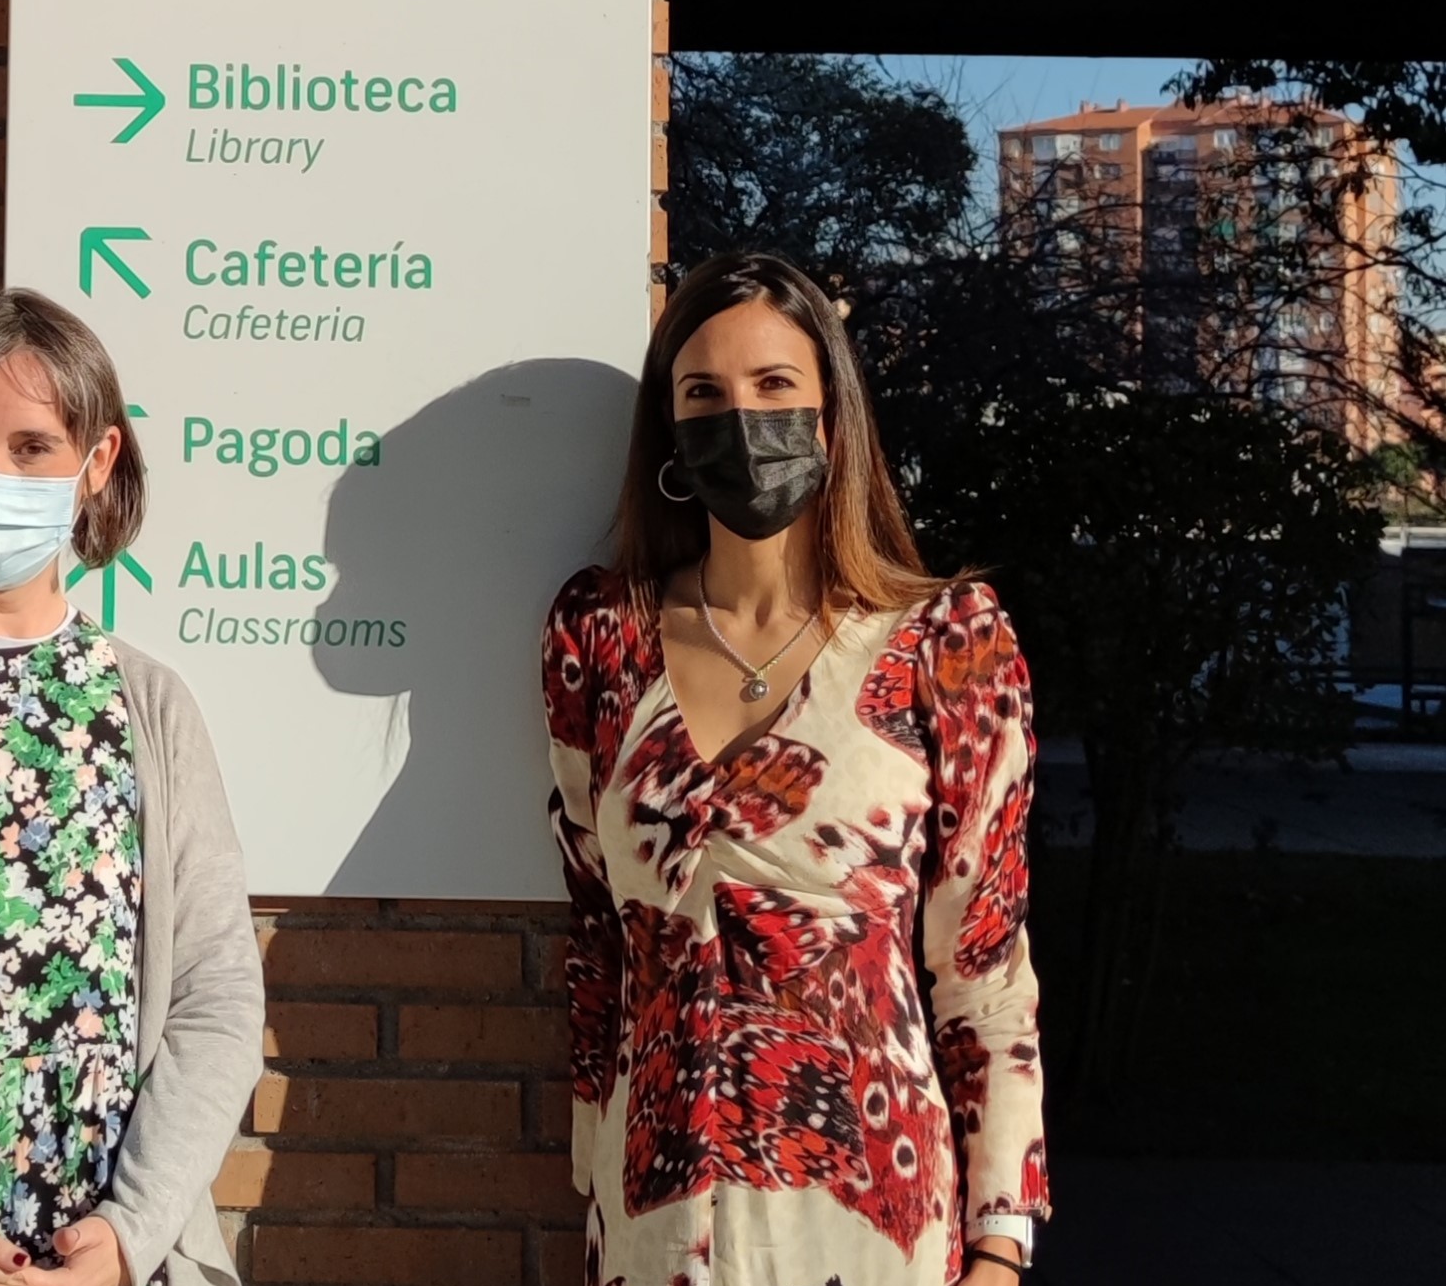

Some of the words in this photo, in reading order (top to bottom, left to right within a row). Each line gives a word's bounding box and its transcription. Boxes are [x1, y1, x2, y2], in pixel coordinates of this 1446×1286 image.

[188, 64, 457, 114] Biblioteca
[184, 129, 325, 174] Library
[184, 239, 433, 290] Cafetería
[183, 305, 366, 343] Cafeteria
[183, 418, 382, 478] Pagoda
[178, 542, 328, 591] Aulas
[177, 608, 407, 648] Classrooms
